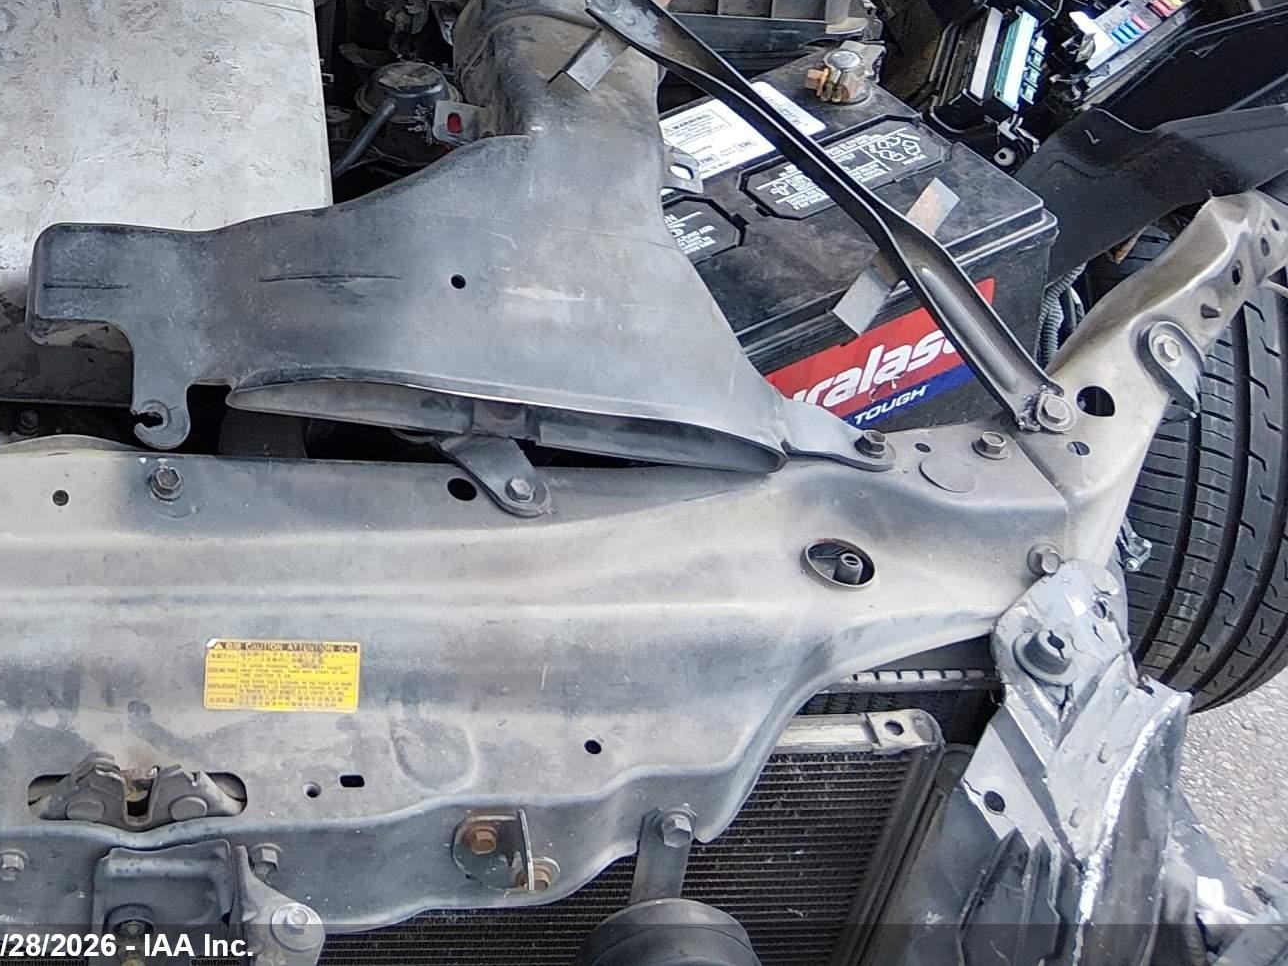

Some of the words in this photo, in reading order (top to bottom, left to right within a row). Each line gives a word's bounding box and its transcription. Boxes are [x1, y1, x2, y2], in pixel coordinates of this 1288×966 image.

[793, 329, 955, 408] ralas
[854, 384, 930, 425] TOUGH
[245, 642, 283, 651] CAUTION
[287, 643, 334, 652] ATTENTION
